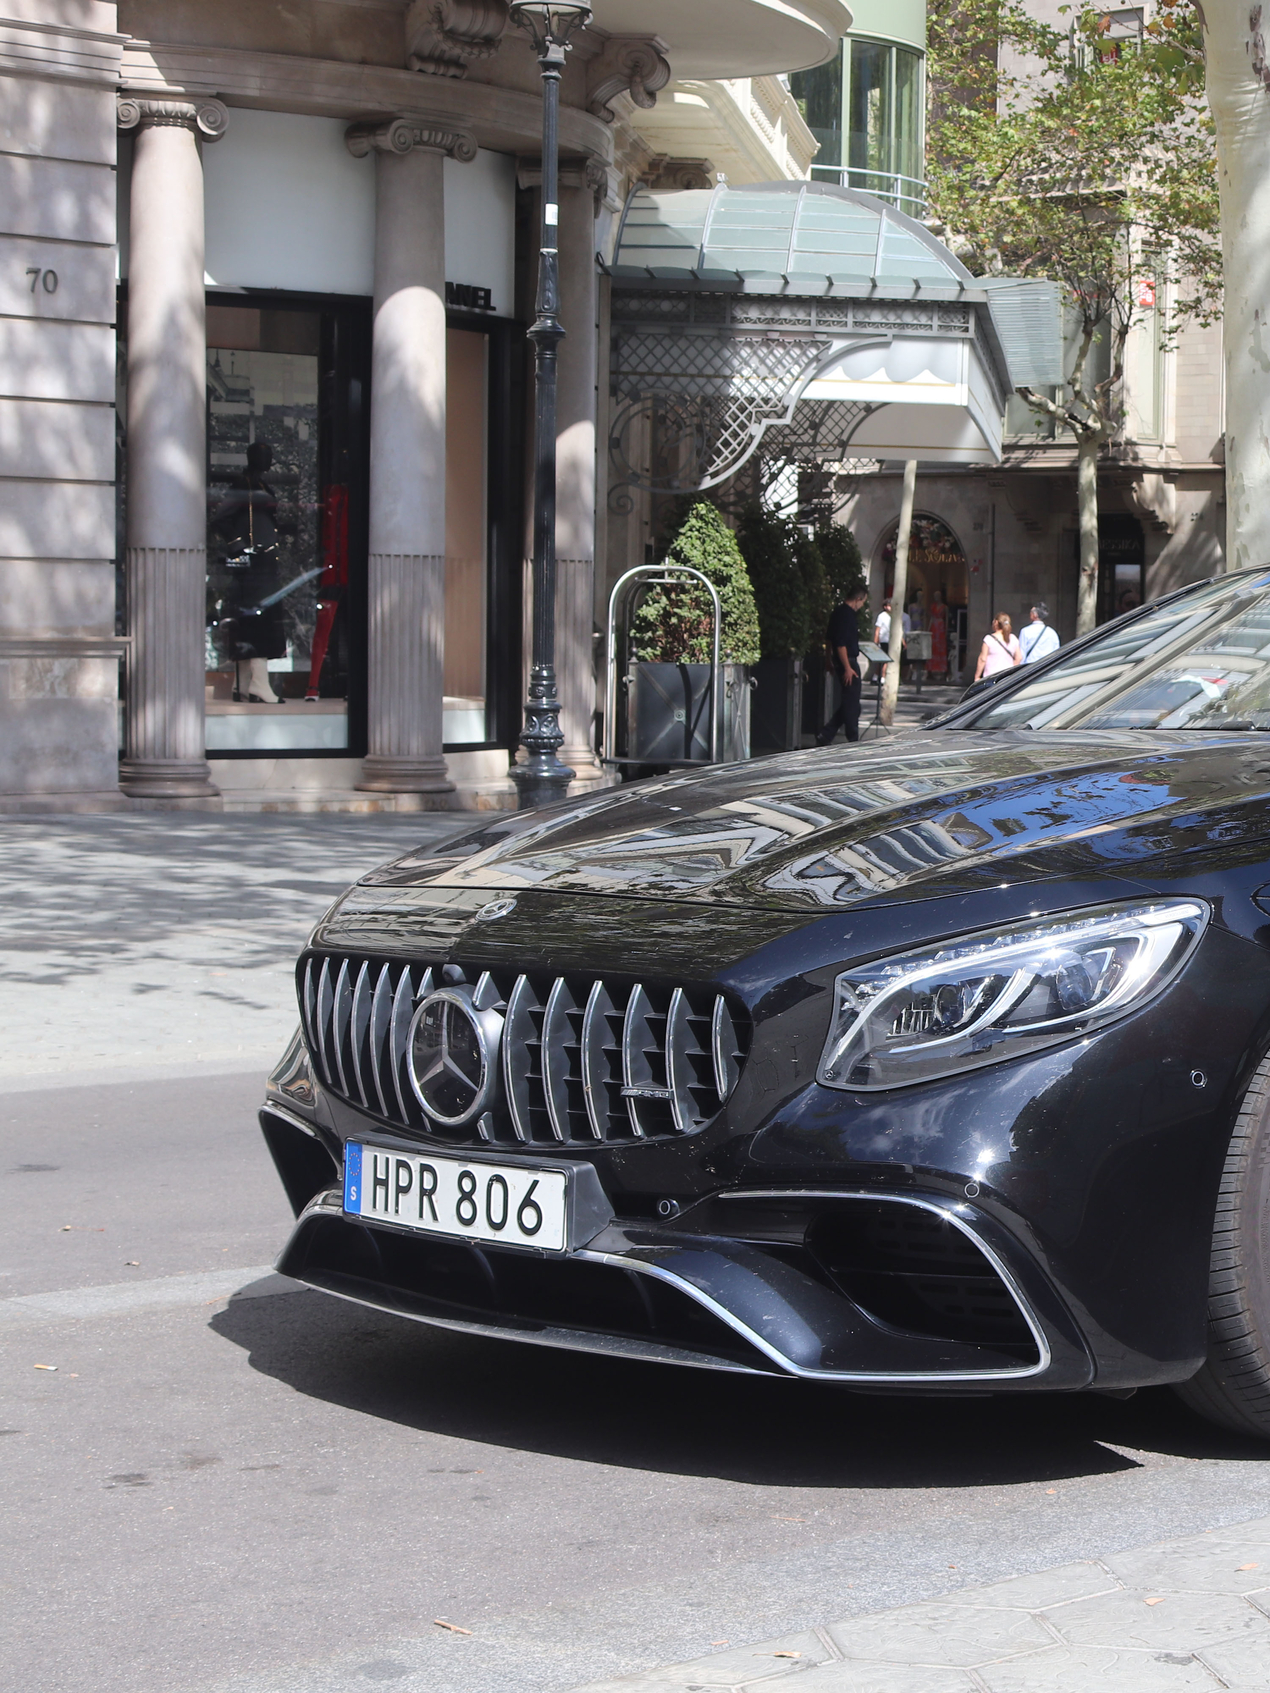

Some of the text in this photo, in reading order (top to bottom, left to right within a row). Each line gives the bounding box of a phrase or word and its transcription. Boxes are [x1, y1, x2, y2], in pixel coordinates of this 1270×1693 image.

[25, 267, 59, 294] 70
[1099, 539, 1141, 550] ESSIKA
[350, 1186, 358, 1202] S
[371, 1153, 544, 1237] HPR 806
